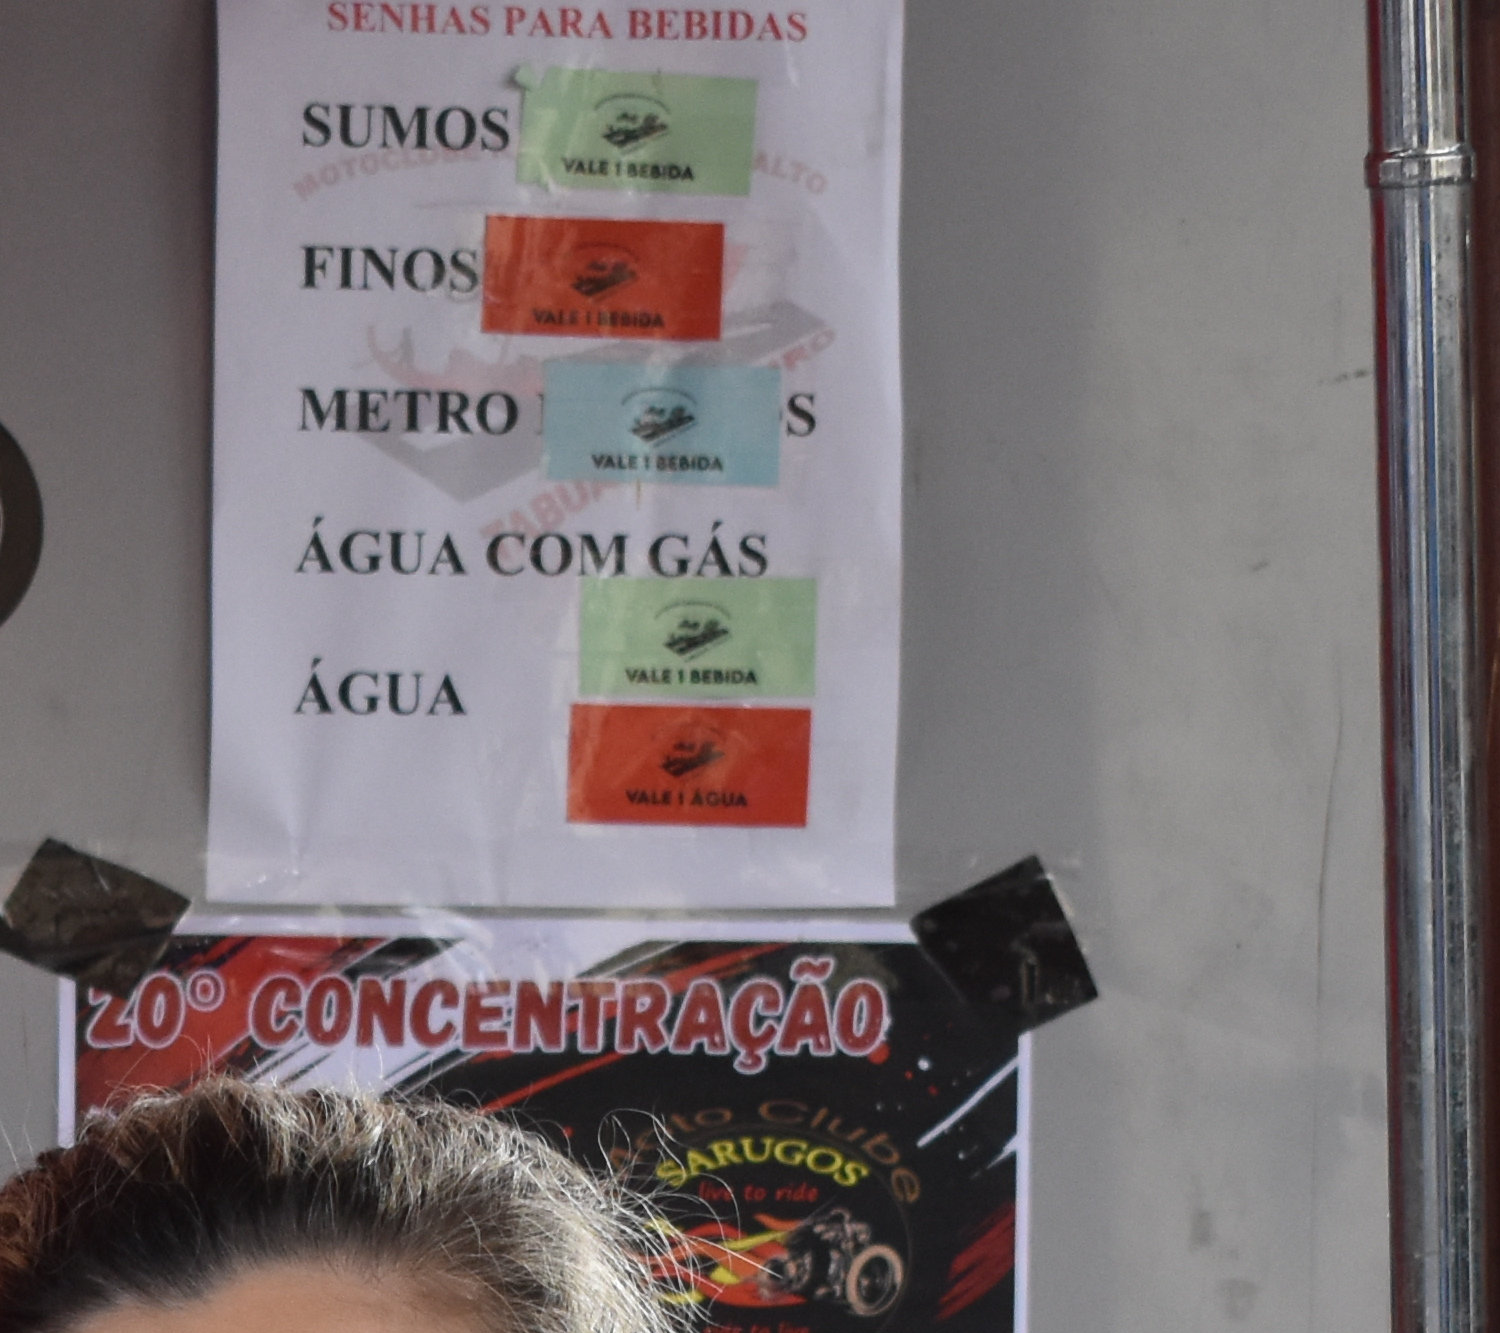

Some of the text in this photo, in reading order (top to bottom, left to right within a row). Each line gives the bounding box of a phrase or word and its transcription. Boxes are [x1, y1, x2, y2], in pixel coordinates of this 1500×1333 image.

[327, 2, 808, 43] SENHAS PARA BEBIDAS
[302, 103, 510, 151] SUMOS
[561, 157, 695, 181] VALE BEBIDA
[303, 247, 479, 292] FINOS
[533, 308, 664, 330] VALE BEBIDA
[299, 387, 518, 436] METRO
[592, 453, 724, 472] VALE BEBIDA
[297, 516, 768, 577] ÁGUA COM GÁS
[295, 658, 466, 716] ÁGUA
[625, 668, 758, 686] VALE BEBIDA
[626, 788, 748, 808] VALE ÁGUA
[248, 957, 888, 1074] CONCENTRAÇÃO
[655, 1136, 871, 1189] SARUGOS
[758, 1099, 921, 1204] Clube
[700, 1181, 819, 1201] live to ride
